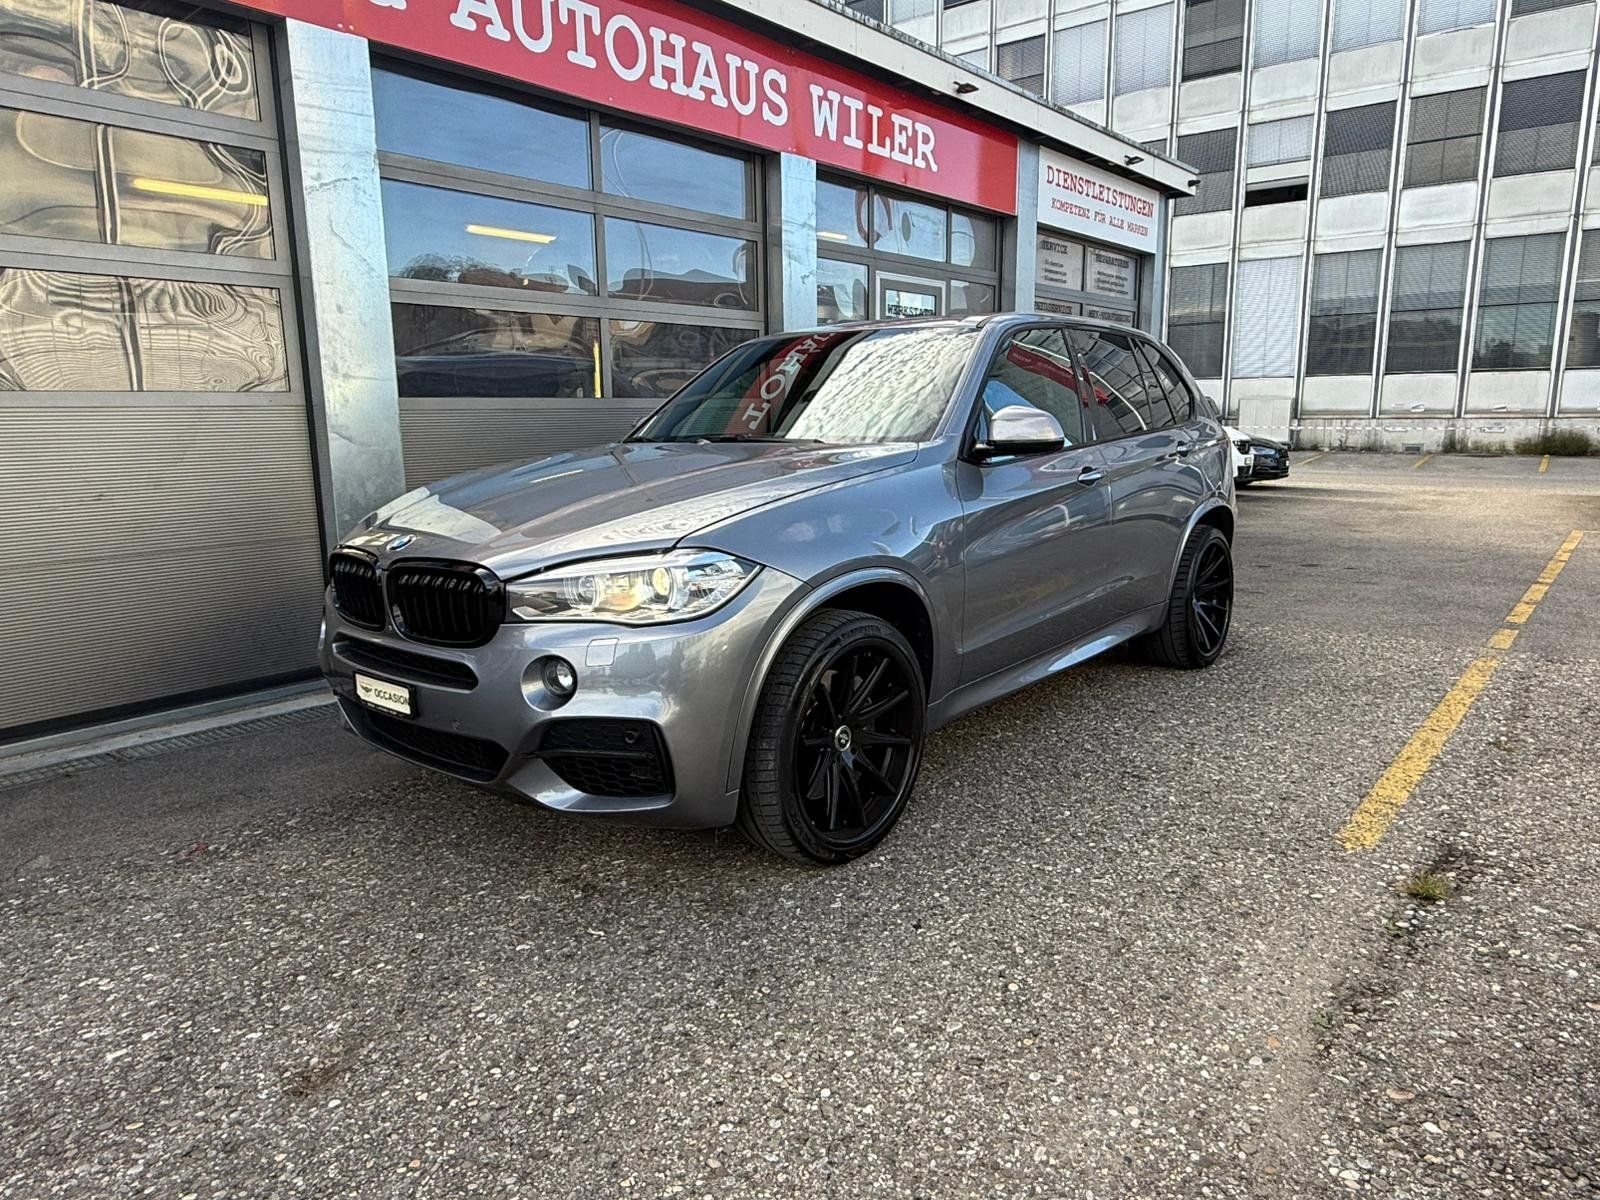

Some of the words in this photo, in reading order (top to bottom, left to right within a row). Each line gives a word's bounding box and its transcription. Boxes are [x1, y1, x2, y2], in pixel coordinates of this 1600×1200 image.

[450, 0, 789, 127] AUTOHAUS
[809, 83, 939, 173] WILER
[1047, 165, 1154, 218] DIENSTLEISTUNGEN
[1051, 198, 1090, 219] KOMPETENZ
[1109, 215, 1125, 229] ALLE
[1041, 240, 1068, 254] SERVICE
[374, 688, 410, 705] OCCASION
